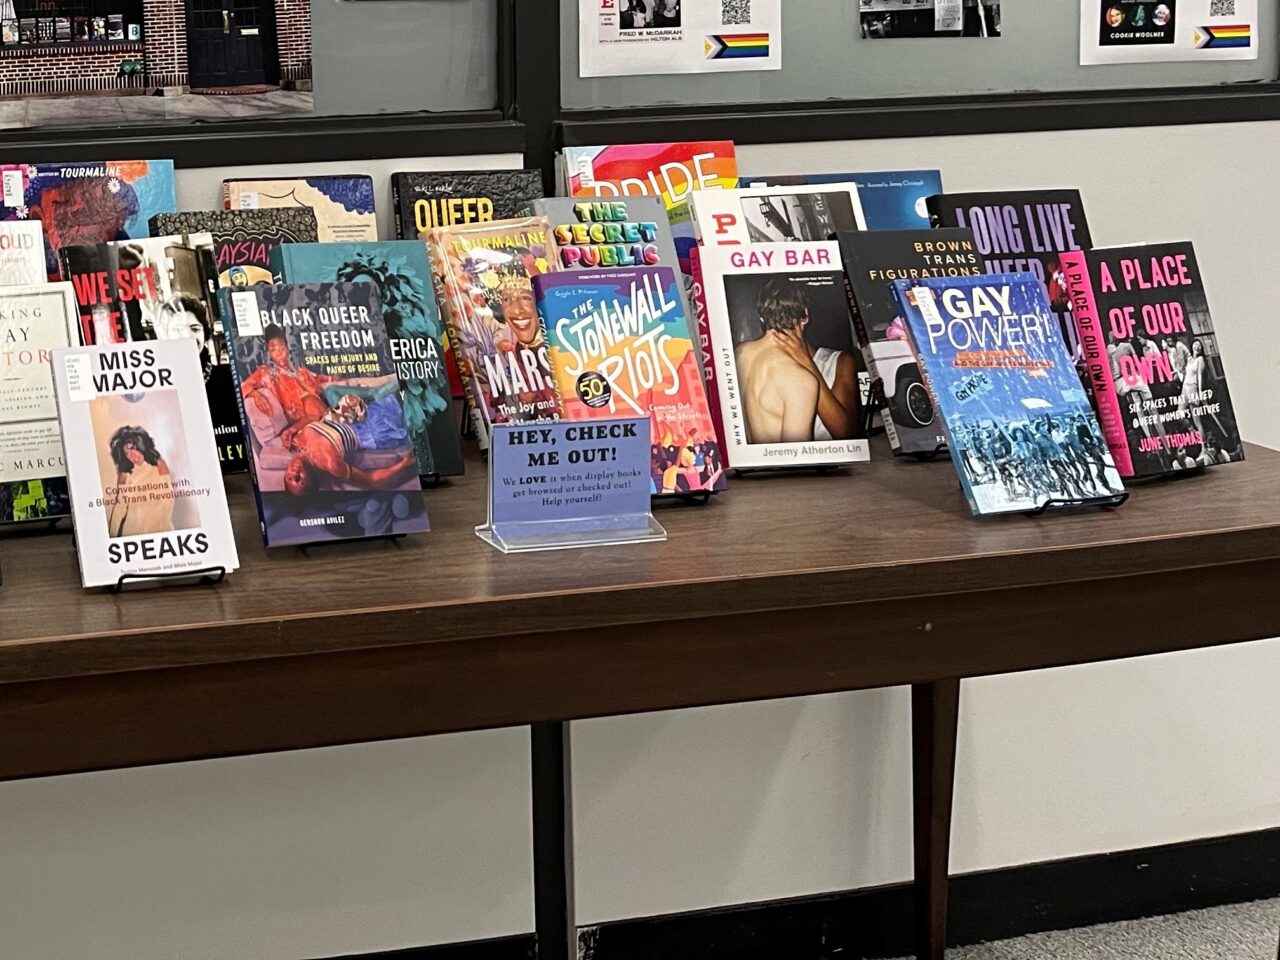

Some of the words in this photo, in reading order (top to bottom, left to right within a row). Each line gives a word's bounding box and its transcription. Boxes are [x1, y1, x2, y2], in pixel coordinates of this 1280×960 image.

[554, 222, 659, 244] SECRET
[560, 244, 661, 267] PUBLIC
[914, 241, 972, 252] BROWN
[731, 251, 774, 268] GAY
[785, 249, 830, 265] BAR
[923, 254, 976, 265] TRANS
[870, 266, 981, 281] FIGURATIONS
[1100, 261, 1117, 293] A
[1120, 254, 1192, 291] PLACE
[943, 286, 1012, 319] GAY
[261, 309, 314, 328] BLACK
[319, 306, 370, 325] QUEER
[1109, 306, 1136, 339] OF
[1141, 302, 1186, 335] OUR
[300, 330, 375, 351] FREEDOM
[927, 313, 1054, 354] POWER!
[99, 349, 155, 370] MISS
[1120, 351, 1174, 386] OWN
[508, 429, 557, 445] HEY,
[565, 423, 637, 442] CHECK
[1139, 437, 1163, 452] JUNE
[1165, 431, 1202, 448] THOMAS
[528, 451, 559, 467] ME
[568, 448, 617, 464] OUT!
[763, 446, 798, 457] Jeremy
[801, 445, 844, 455] Atherton
[847, 444, 861, 452] Lin
[503, 478, 516, 486] We
[520, 476, 546, 484] LOVE
[585, 471, 614, 480] display
[618, 469, 641, 478] books
[542, 497, 562, 506] Help
[565, 494, 602, 505] yourself!
[108, 532, 209, 564] SPEAKS
